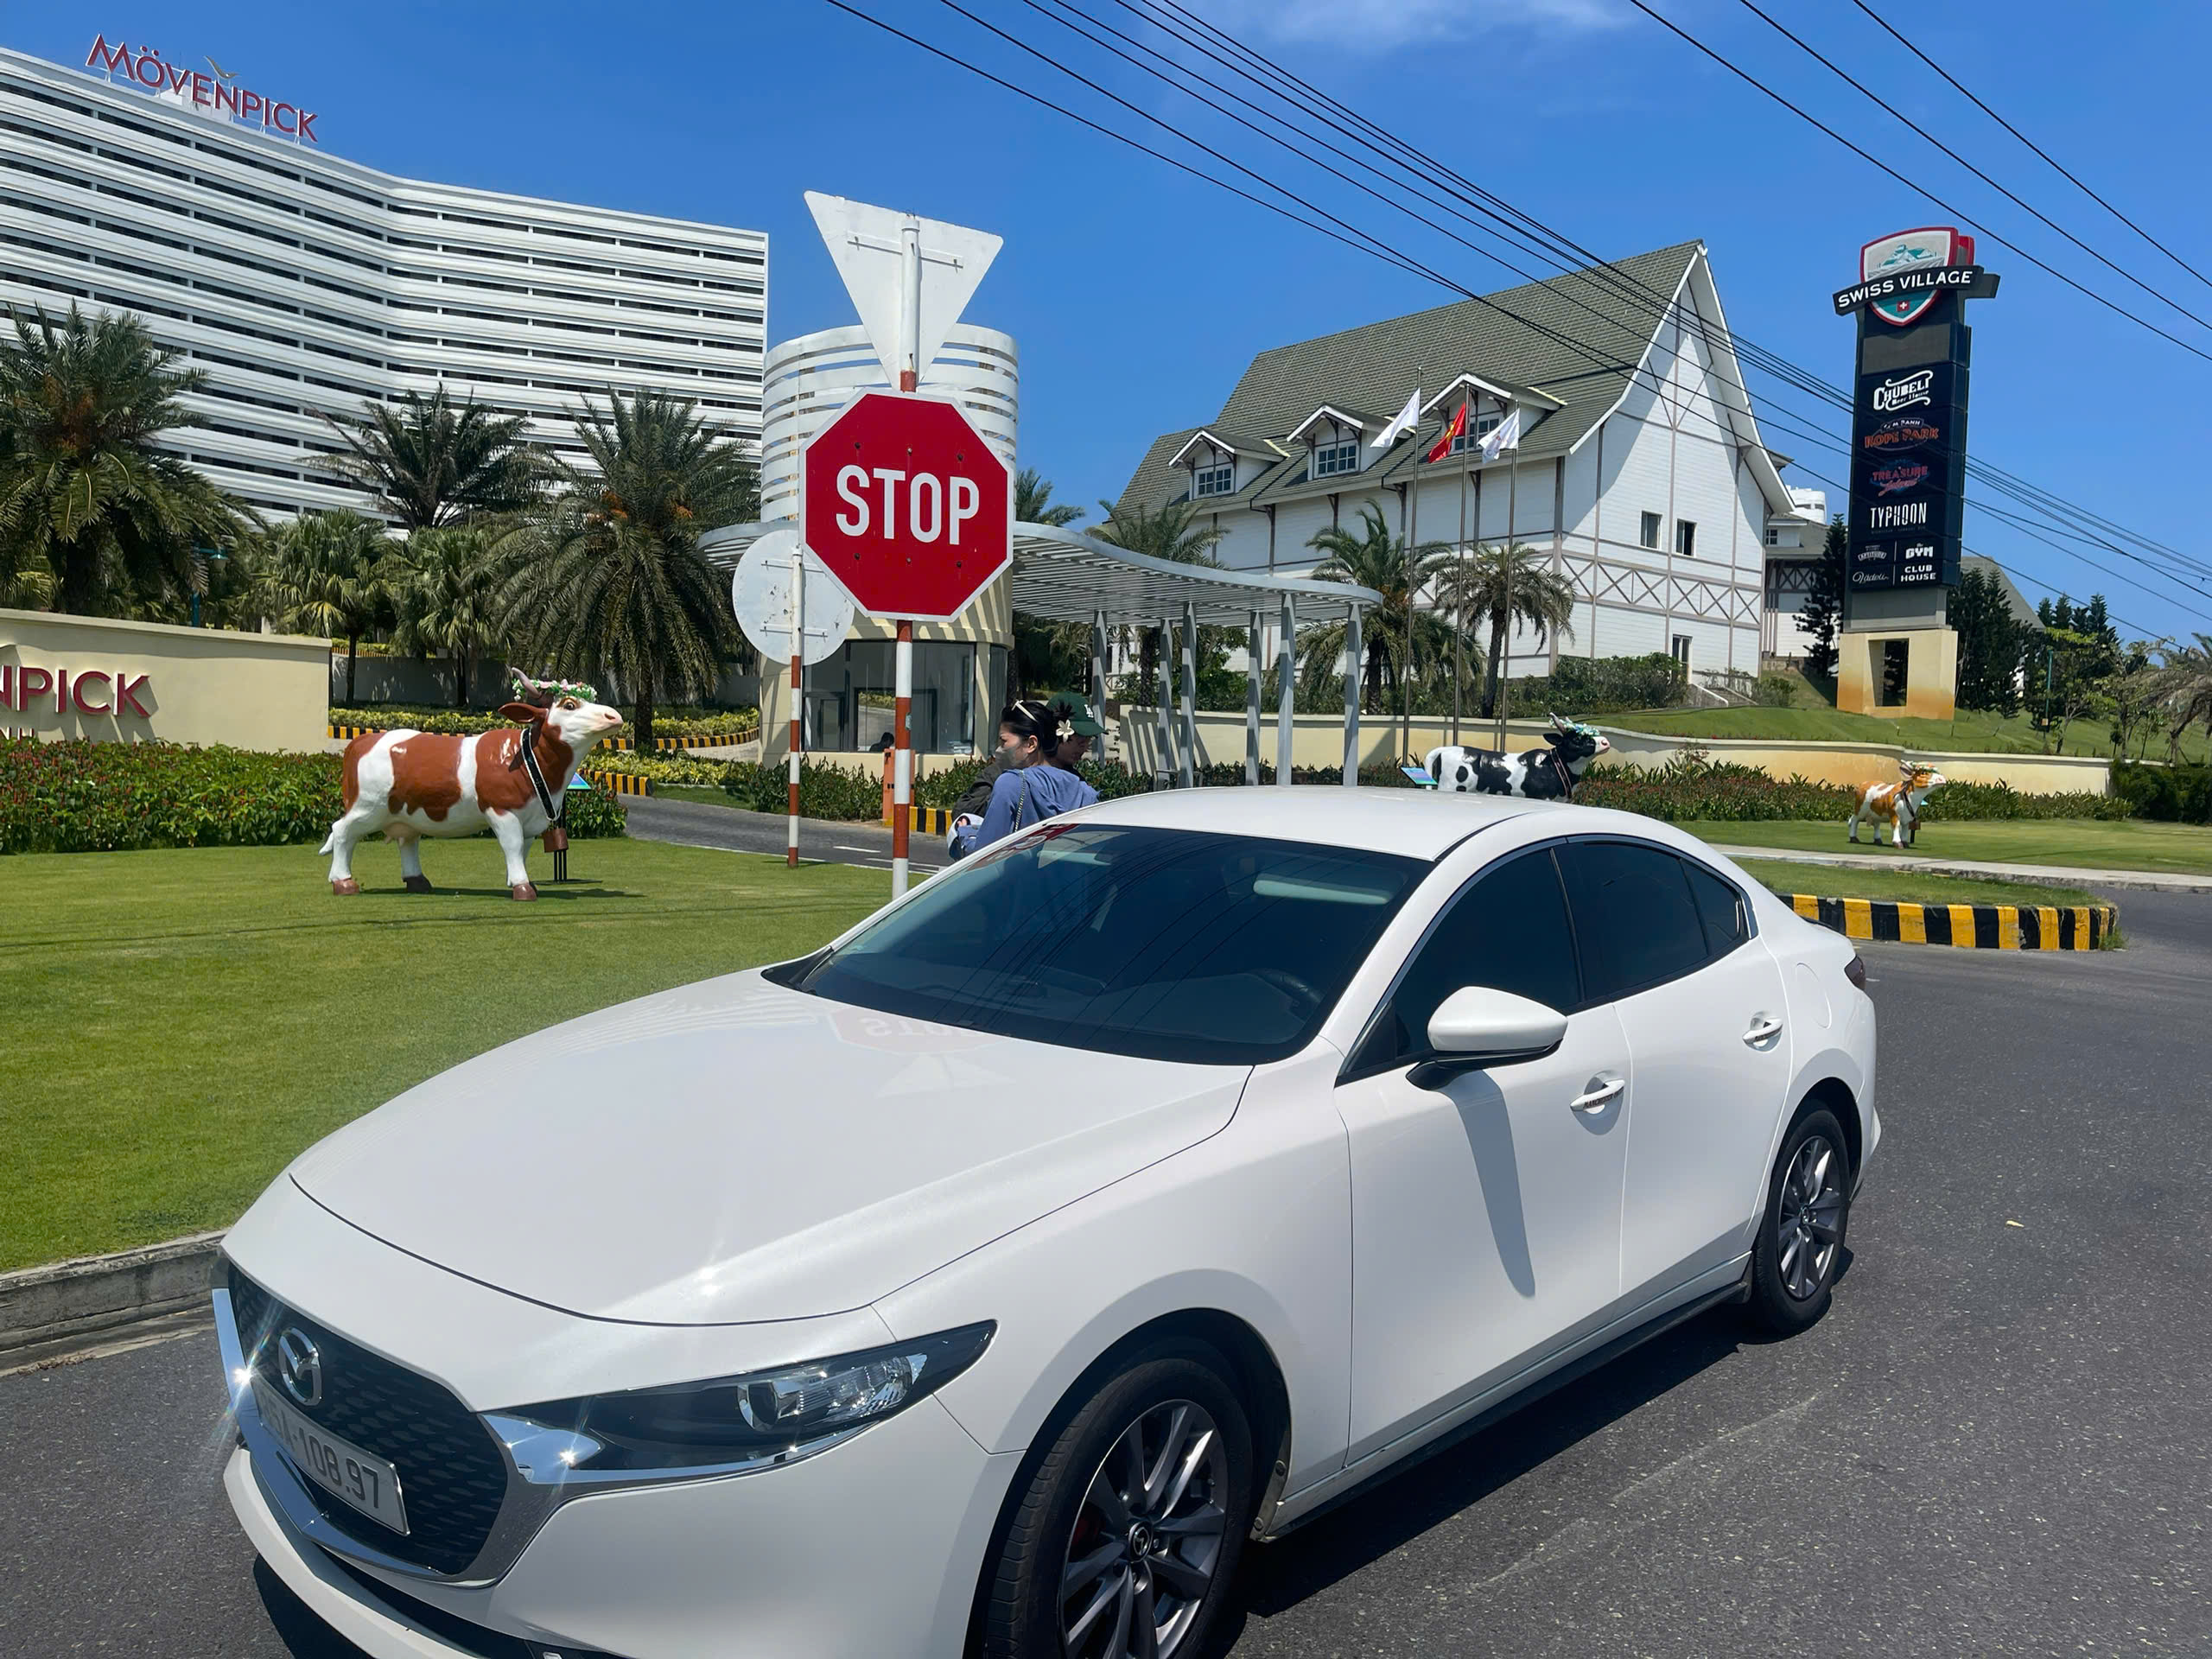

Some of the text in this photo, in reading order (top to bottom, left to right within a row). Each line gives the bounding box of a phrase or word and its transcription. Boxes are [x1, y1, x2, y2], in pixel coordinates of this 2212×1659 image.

[86, 33, 318, 143] MÖVENPICK
[1838, 270, 1974, 308] SWISS VILLAGE
[836, 464, 980, 545] STOP
[1871, 502, 1928, 528] TYPHOON
[1905, 546, 1934, 560] GYM
[1901, 572, 1936, 582] HOUSE
[1904, 564, 1933, 574] CLUB
